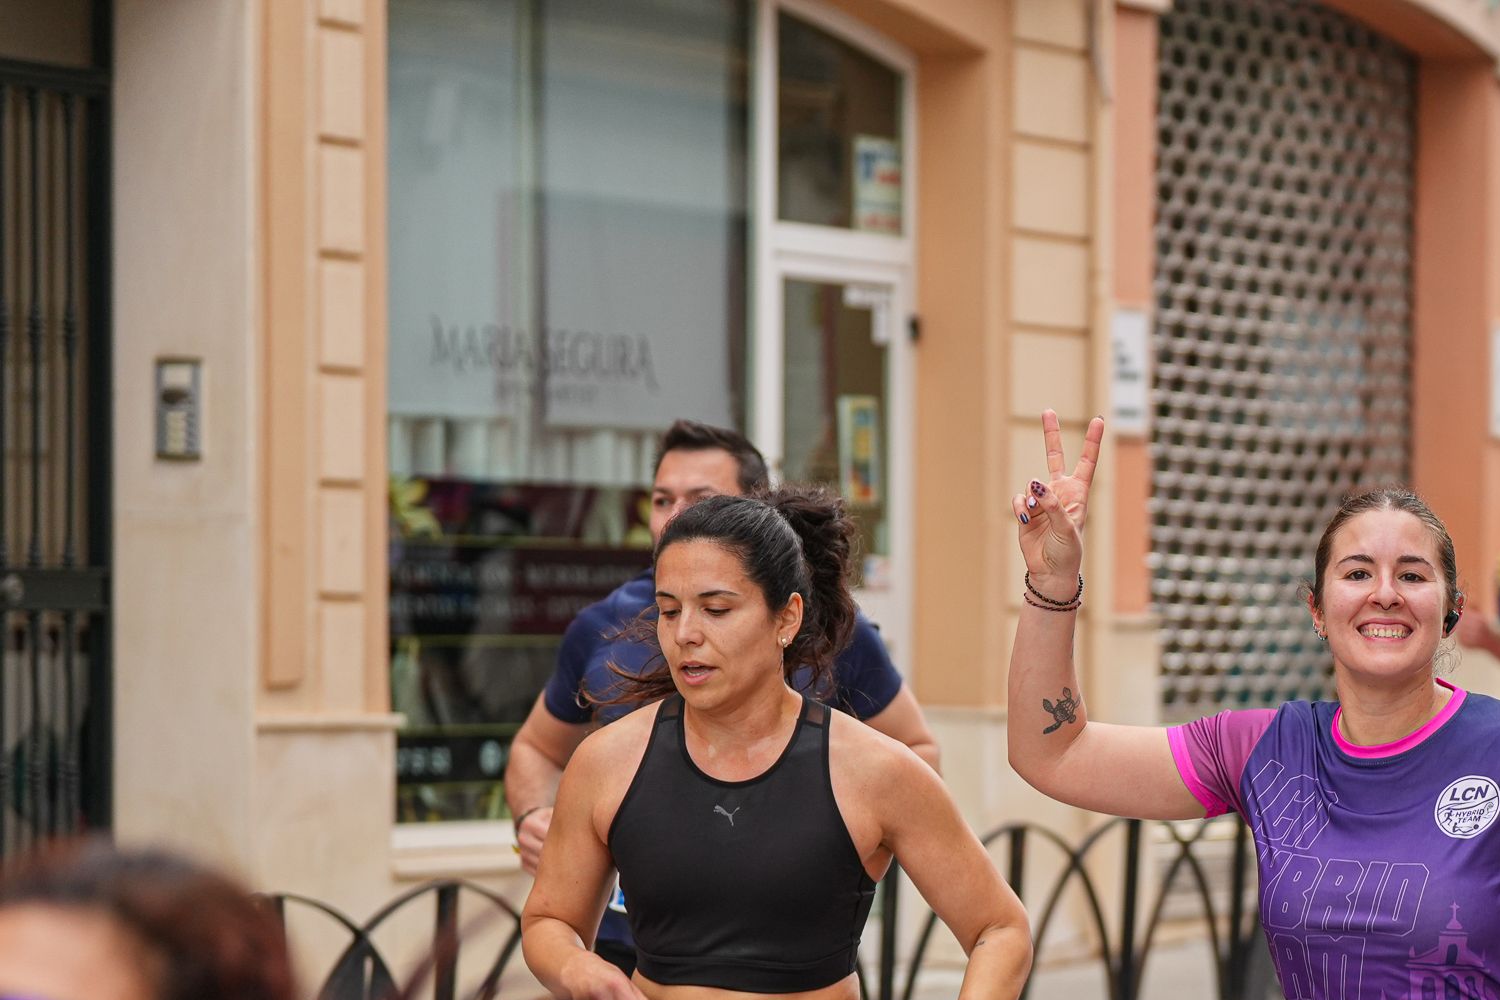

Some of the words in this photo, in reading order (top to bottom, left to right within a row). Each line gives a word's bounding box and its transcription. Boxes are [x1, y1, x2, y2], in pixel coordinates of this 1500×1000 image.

[1449, 785, 1490, 801] LCN
[1455, 808, 1485, 817] HYBRID
[1458, 815, 1482, 823] TEAM
[1256, 840, 1430, 937] YBRID
